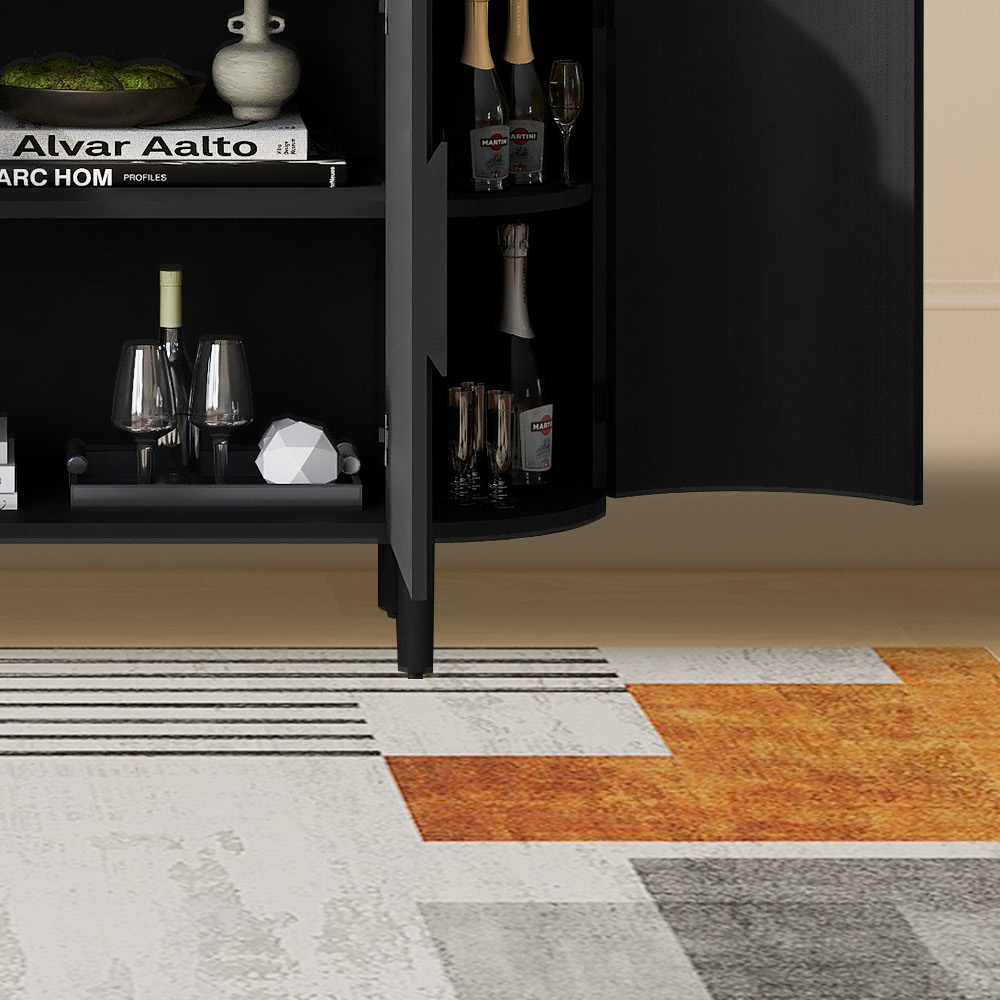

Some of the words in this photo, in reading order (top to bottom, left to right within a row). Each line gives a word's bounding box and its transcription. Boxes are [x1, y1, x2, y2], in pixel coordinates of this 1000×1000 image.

[13, 134, 131, 156] Alvar
[141, 135, 258, 157] Aalto
[482, 138, 507, 146] MARTIN
[54, 168, 113, 186] HOM
[123, 173, 167, 182] PROFILES
[532, 421, 552, 430] MART
